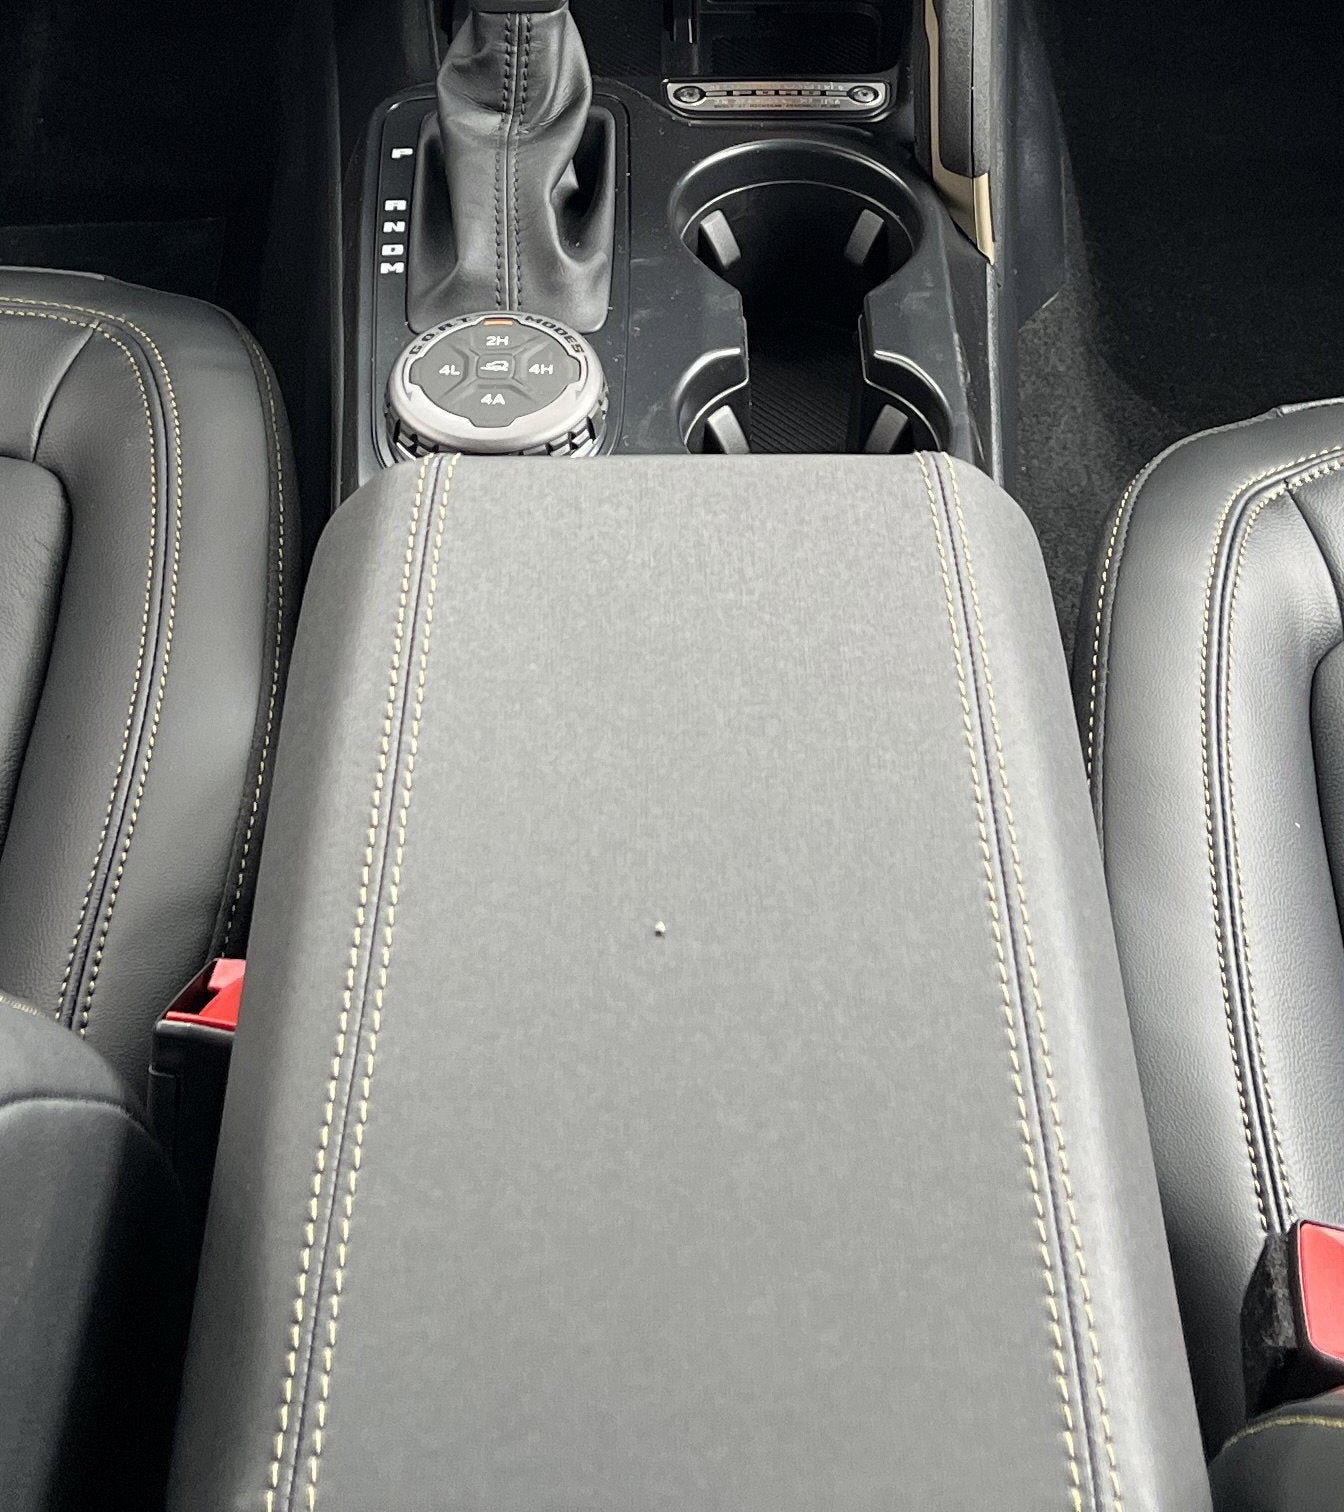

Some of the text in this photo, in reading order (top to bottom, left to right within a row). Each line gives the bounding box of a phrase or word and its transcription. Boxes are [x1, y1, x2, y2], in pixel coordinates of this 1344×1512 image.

[391, 148, 414, 159] P
[384, 199, 407, 211] R
[383, 221, 406, 233] N
[381, 244, 404, 256] D
[380, 262, 404, 274] M
[486, 335, 509, 346] 2H
[525, 315, 585, 354] MODES
[438, 364, 461, 376] 4L
[528, 364, 554, 375] 4H
[480, 393, 506, 406] 4A
